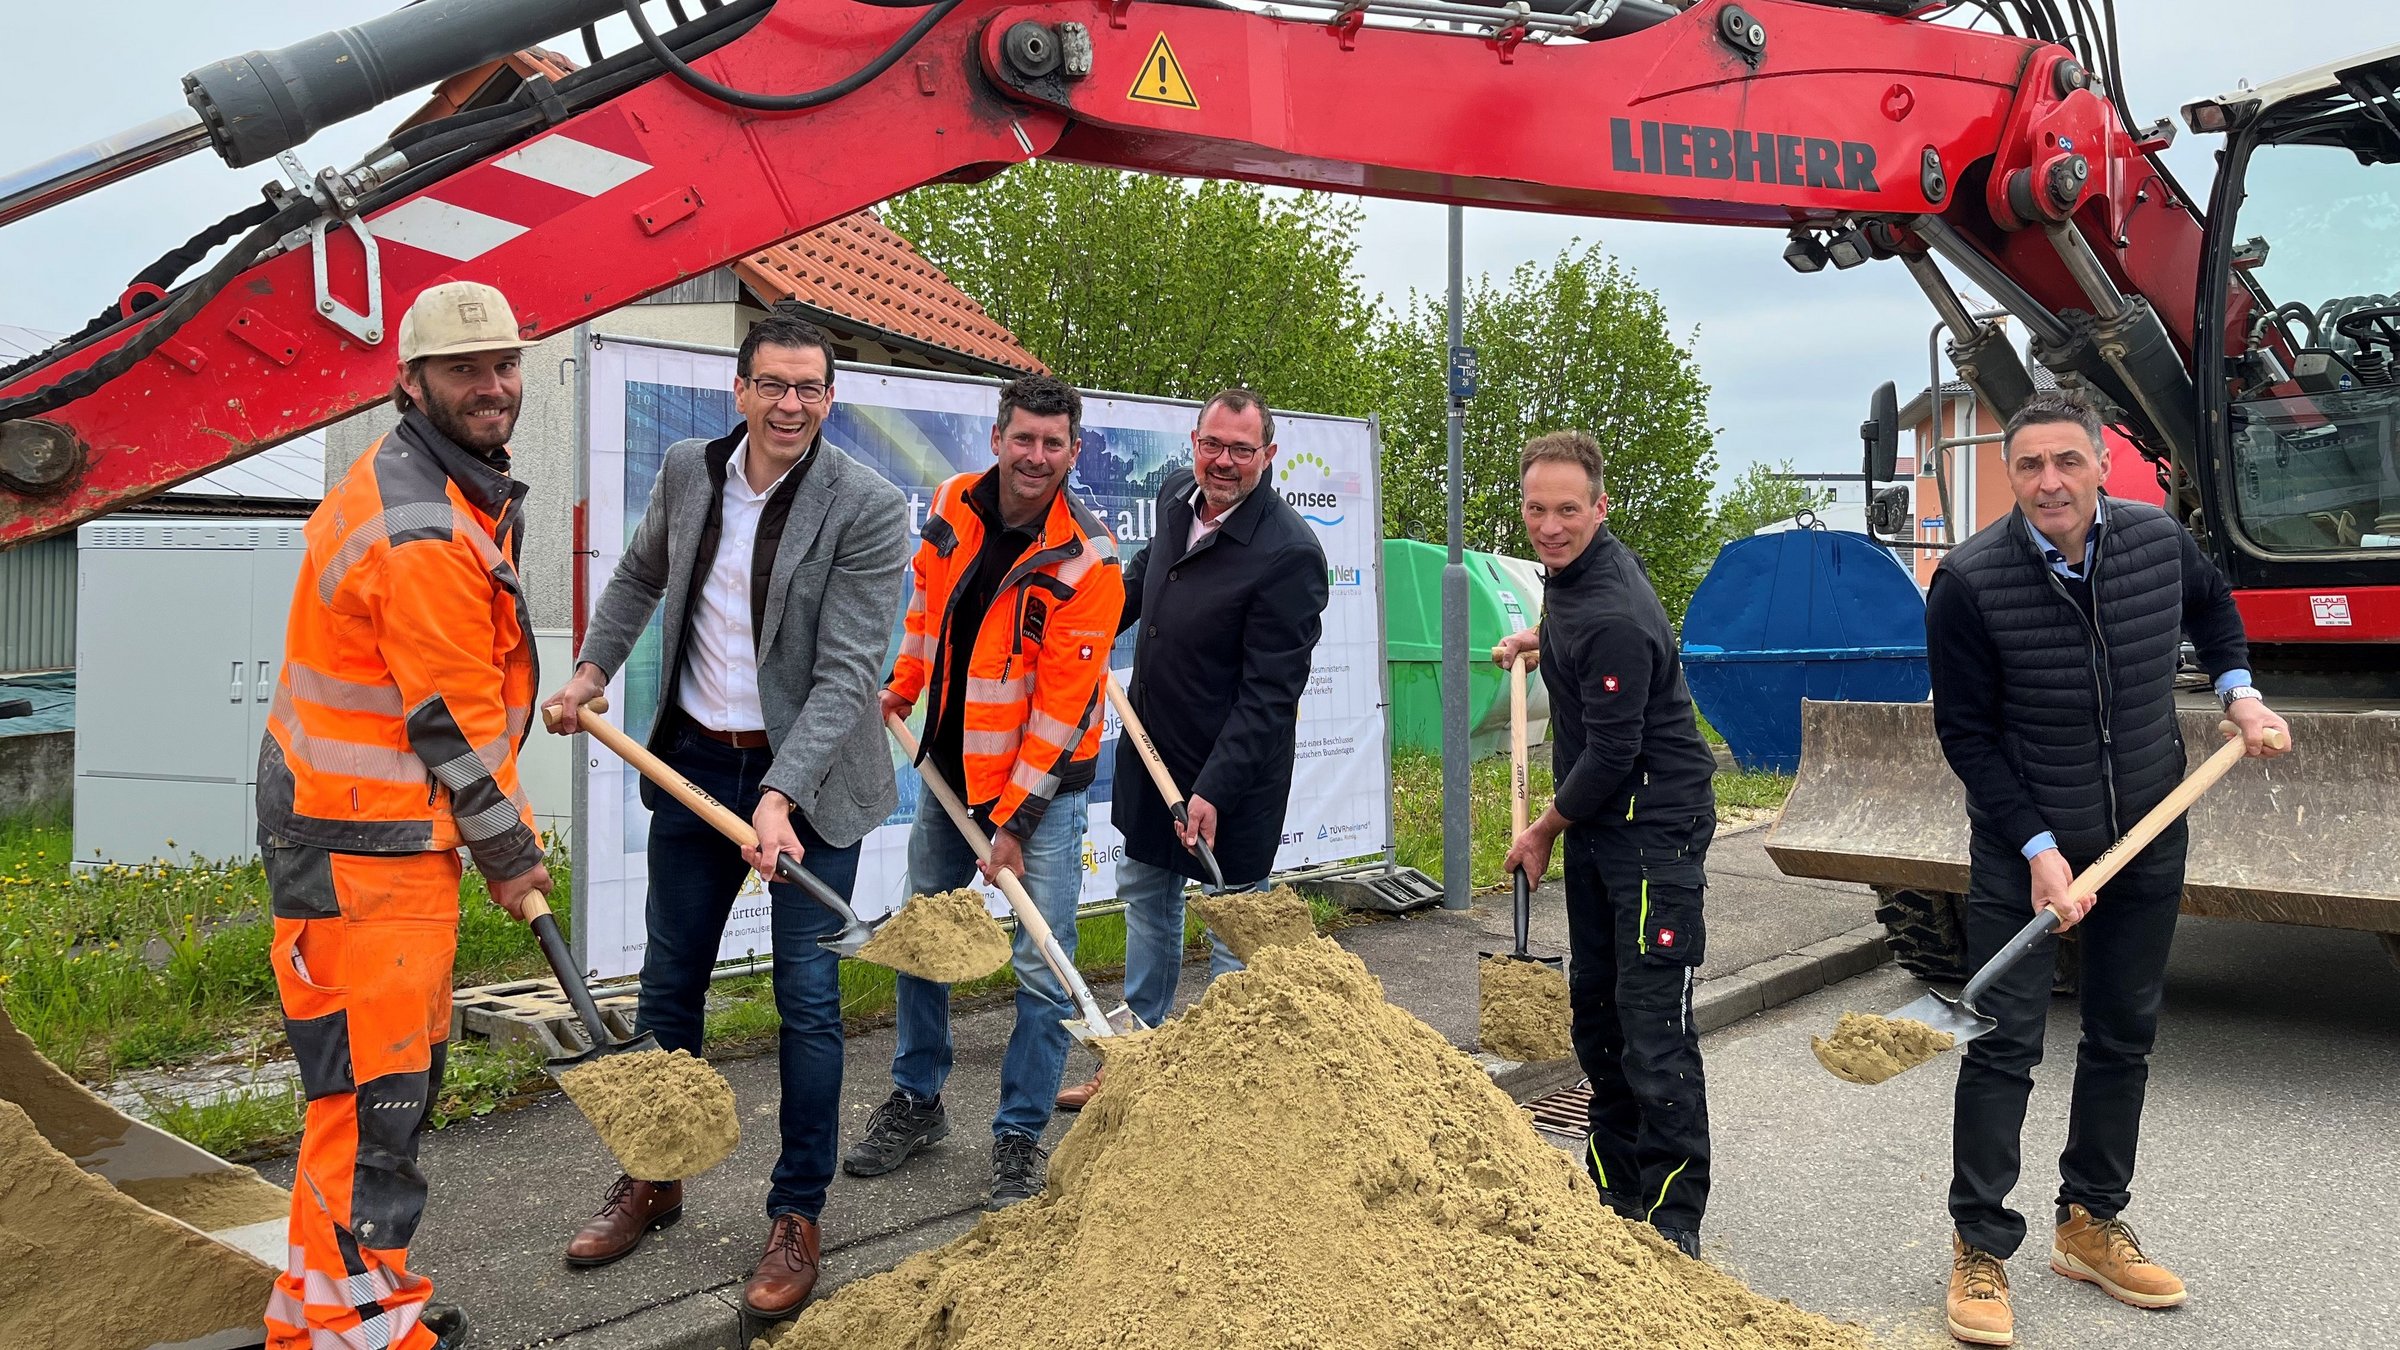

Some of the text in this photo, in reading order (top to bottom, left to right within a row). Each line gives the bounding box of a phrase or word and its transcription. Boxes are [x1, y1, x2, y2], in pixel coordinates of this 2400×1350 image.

[1610, 117, 1881, 192] LIEBHERR
[1466, 359, 1475, 367] 100
[1334, 564, 1355, 582] Net
[1311, 663, 1351, 674] desministerium
[1313, 686, 1333, 695] Verkehr
[1140, 732, 1161, 762] DARBY
[1516, 762, 1525, 800] DARBY
[682, 781, 721, 807] DARBY
